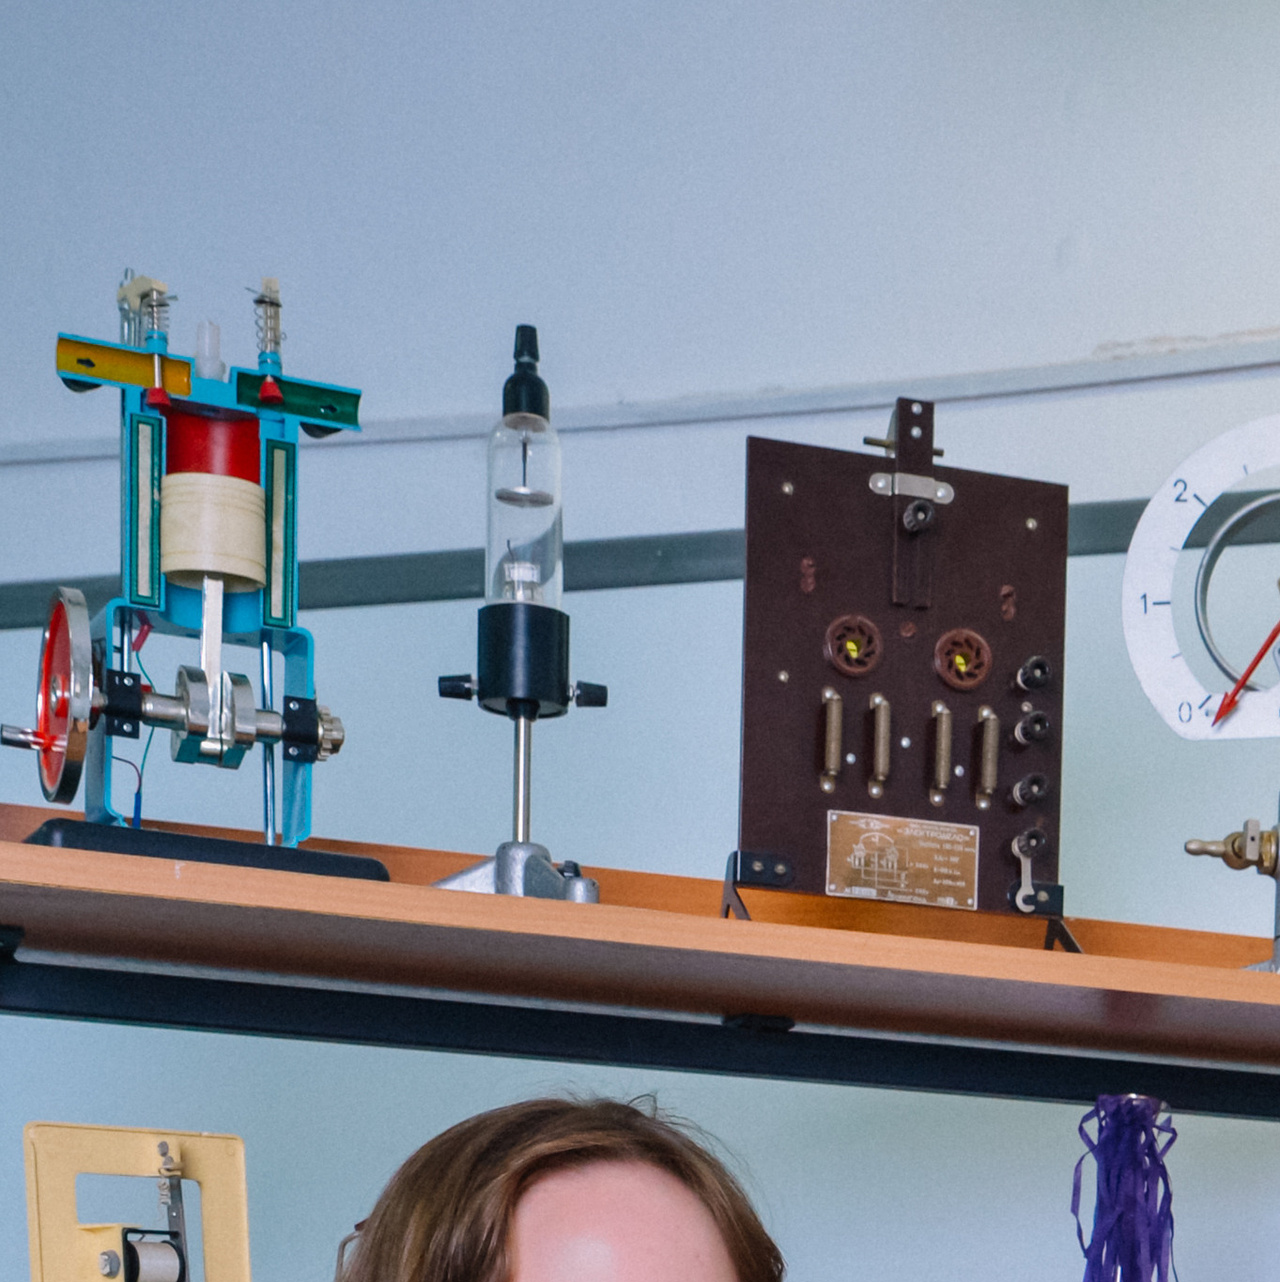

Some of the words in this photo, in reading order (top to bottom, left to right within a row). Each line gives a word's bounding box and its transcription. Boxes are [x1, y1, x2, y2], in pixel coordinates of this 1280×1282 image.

[1173, 479, 1189, 503] 2
[1139, 593, 1149, 615] 1
[1178, 702, 1193, 724] 0
